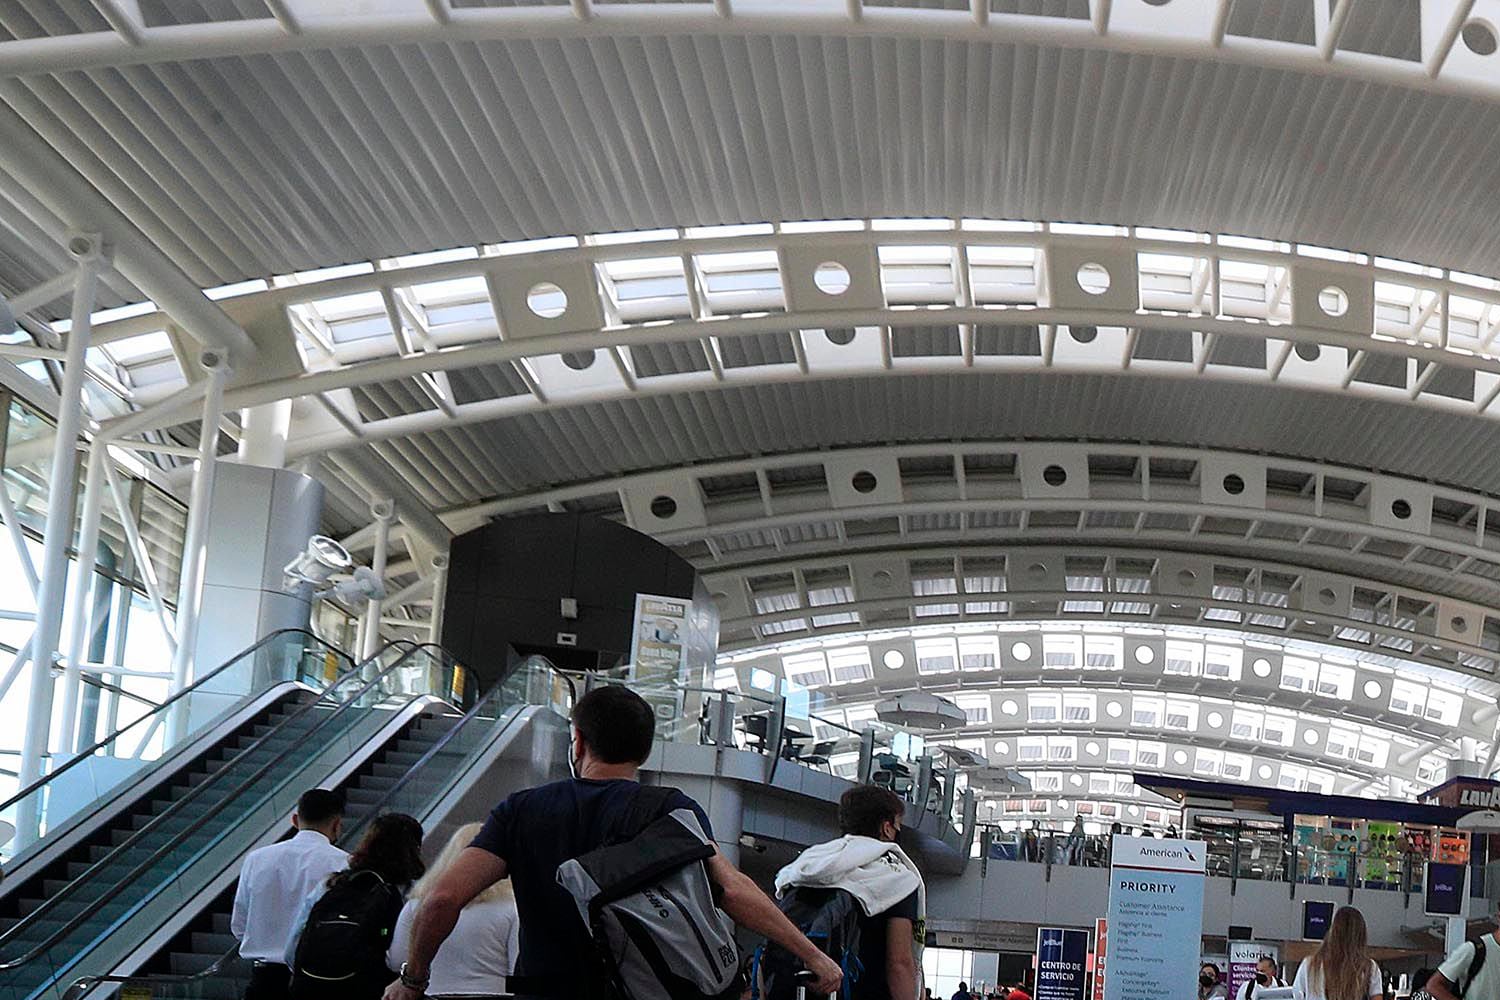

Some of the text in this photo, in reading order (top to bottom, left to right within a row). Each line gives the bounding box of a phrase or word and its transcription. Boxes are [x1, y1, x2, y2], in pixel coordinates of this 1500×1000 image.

[1140, 847, 1183, 858] American
[1120, 881, 1176, 894] PRIORITY
[1041, 961, 1081, 971] CENTRO DE
[1040, 971, 1074, 980] SERVICIO
